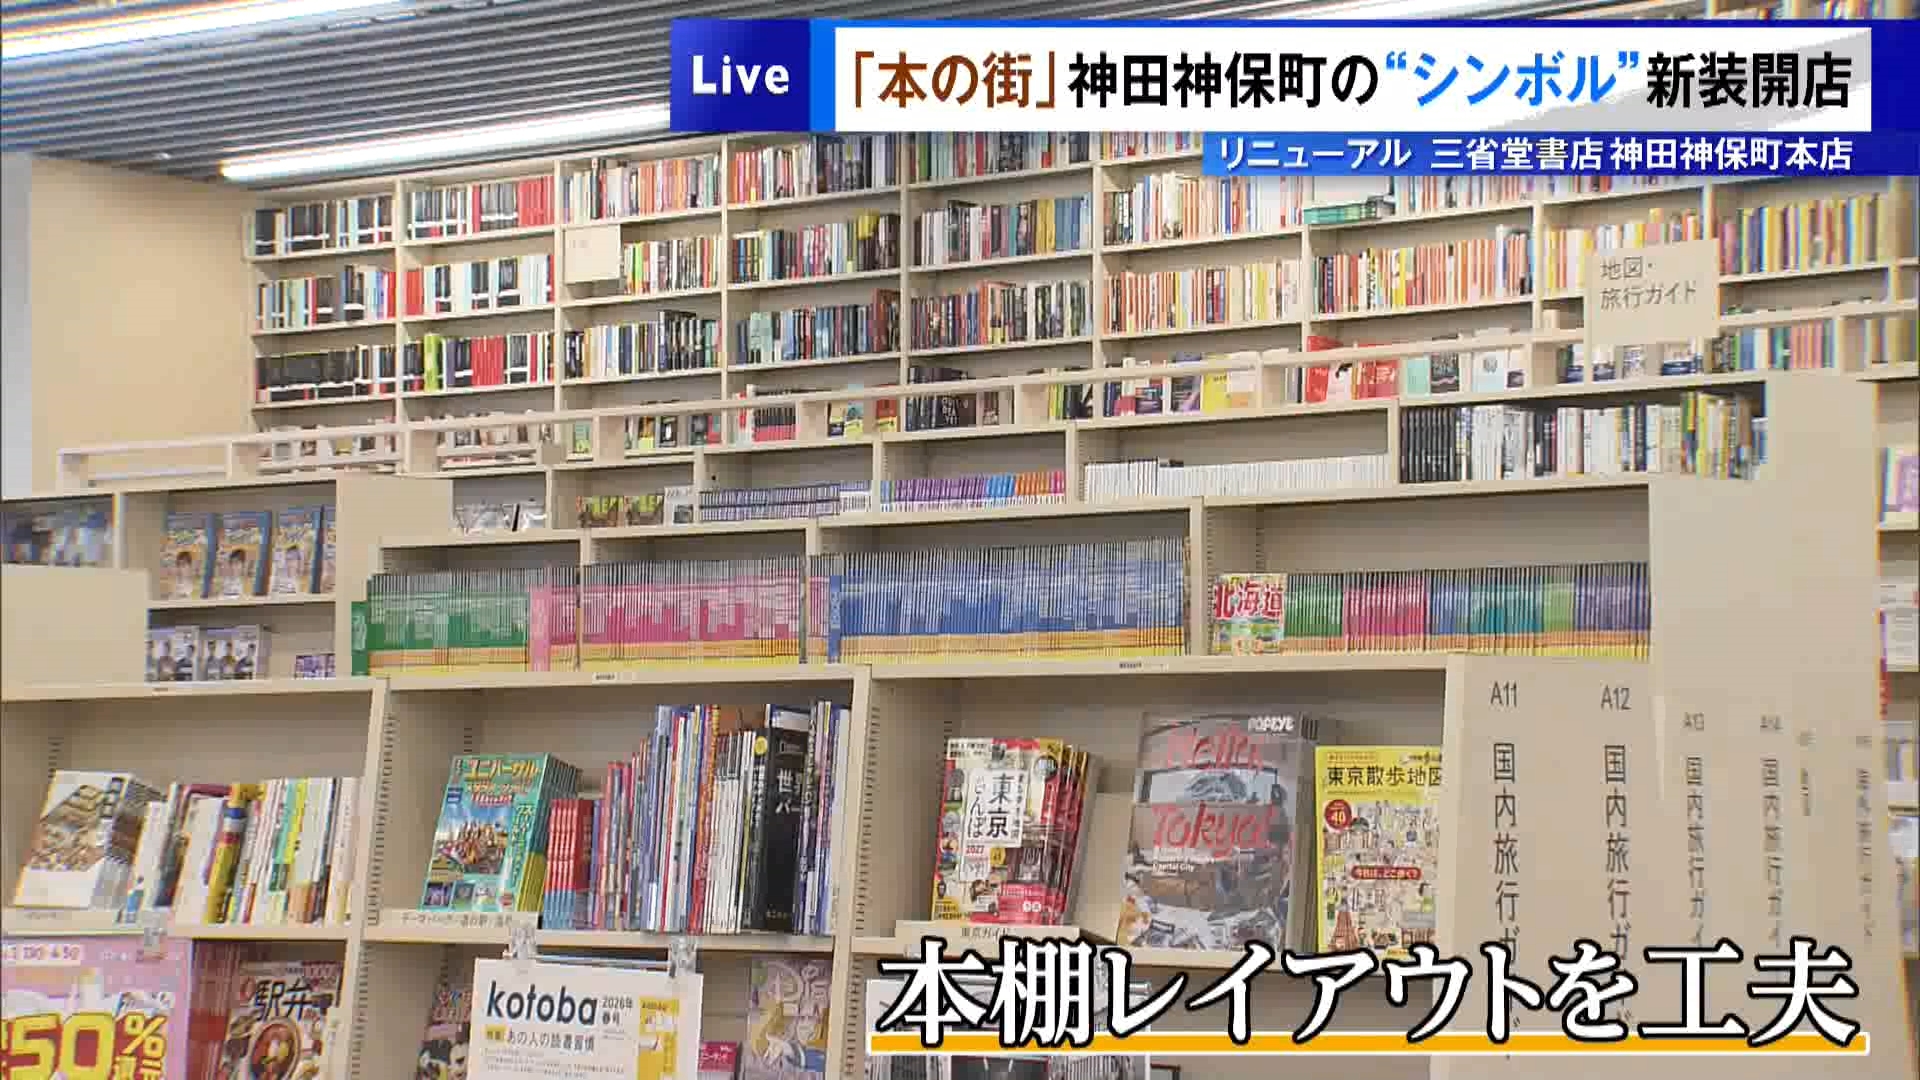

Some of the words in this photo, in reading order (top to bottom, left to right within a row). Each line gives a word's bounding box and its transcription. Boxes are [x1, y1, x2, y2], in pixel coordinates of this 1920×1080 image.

[1600, 280, 1696, 310] 旅行ガイド
[1214, 580, 1284, 619] 北海道
[1490, 681, 1518, 708] A11
[1601, 684, 1632, 711] A12
[985, 773, 1015, 839] 東京
[486, 980, 599, 1026] kotoba
